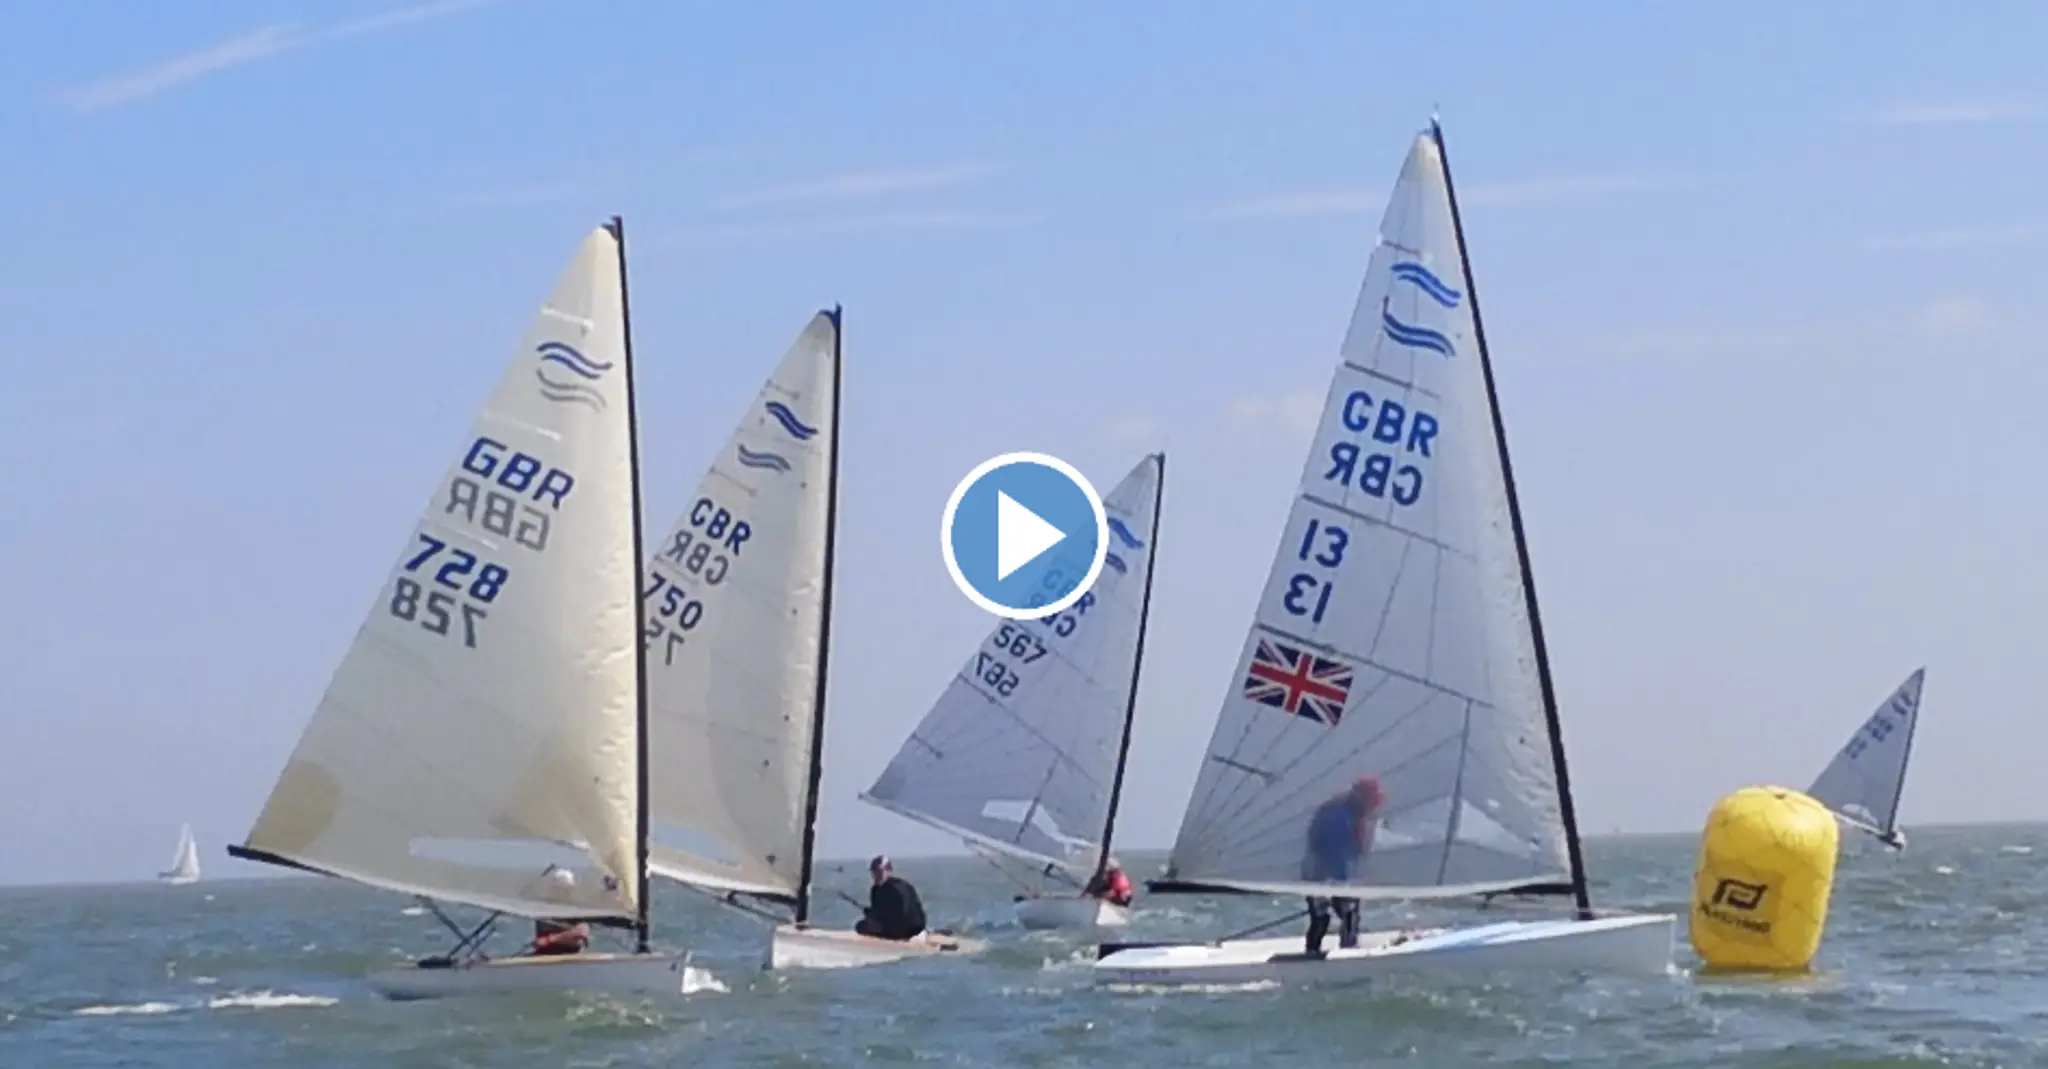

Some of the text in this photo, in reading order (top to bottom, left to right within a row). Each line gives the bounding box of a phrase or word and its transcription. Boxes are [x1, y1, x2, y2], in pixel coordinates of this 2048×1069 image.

[1342, 391, 1438, 458] GBR
[462, 437, 574, 510] GBR
[690, 498, 752, 556] GBR
[1299, 518, 1348, 568] 13
[405, 533, 509, 603] 728
[643, 572, 703, 631] 750
[993, 625, 1047, 664] 567
